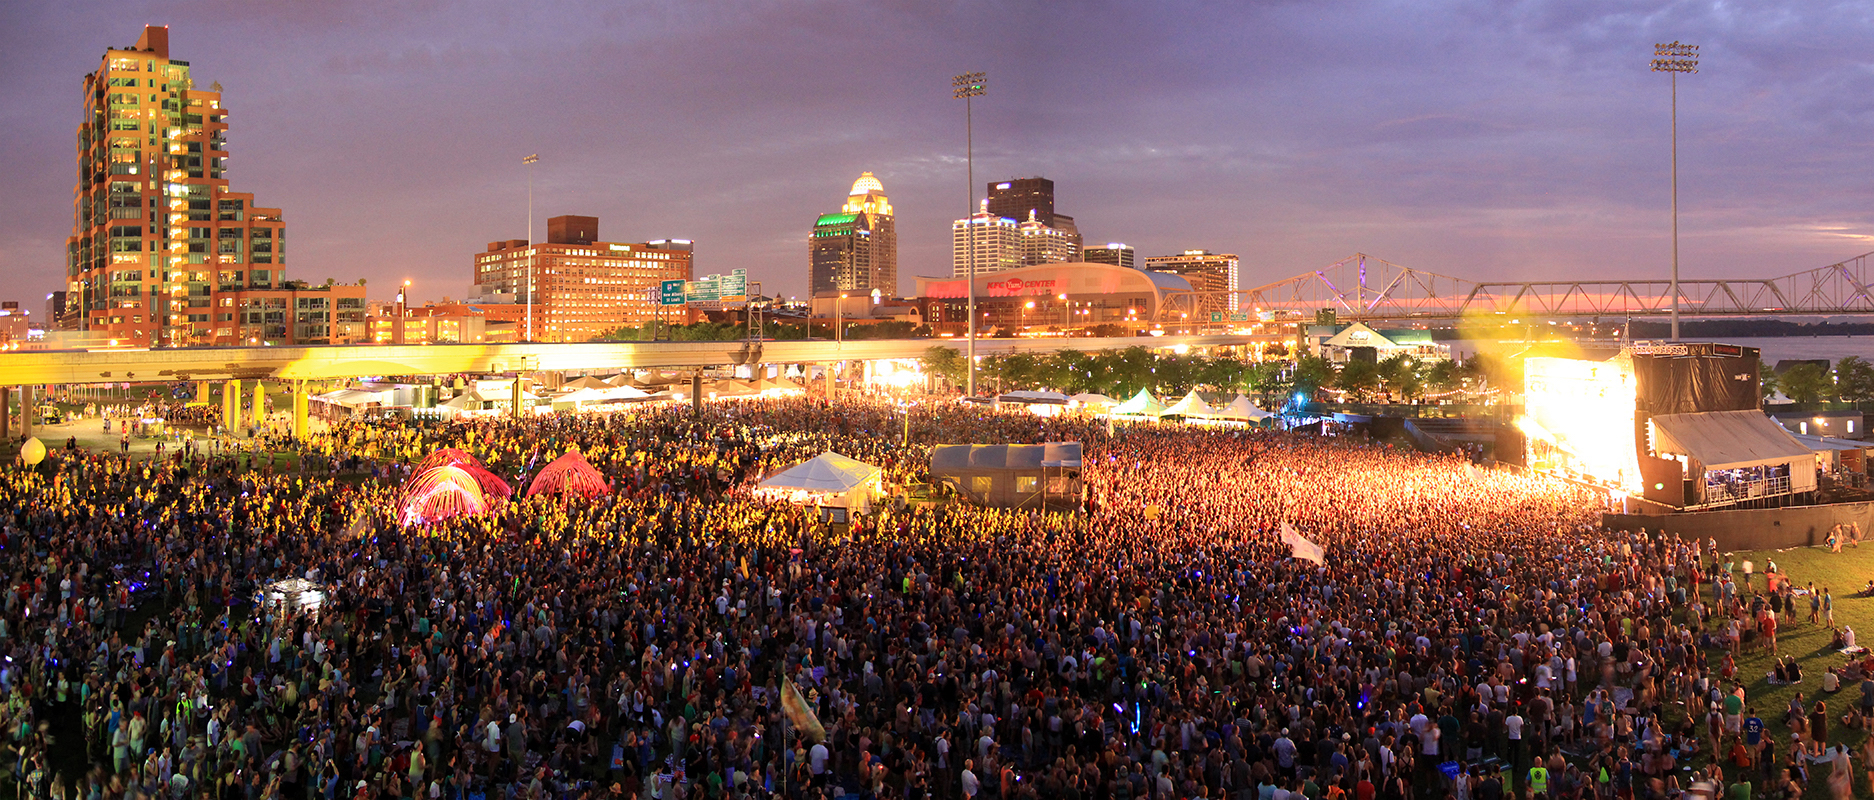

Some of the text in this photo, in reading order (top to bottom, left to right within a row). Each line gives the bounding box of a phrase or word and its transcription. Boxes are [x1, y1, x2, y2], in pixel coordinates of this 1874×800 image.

[987, 281, 1005, 289] KFC
[1025, 280, 1055, 288] CENTER
[1749, 725, 1759, 733] 32
